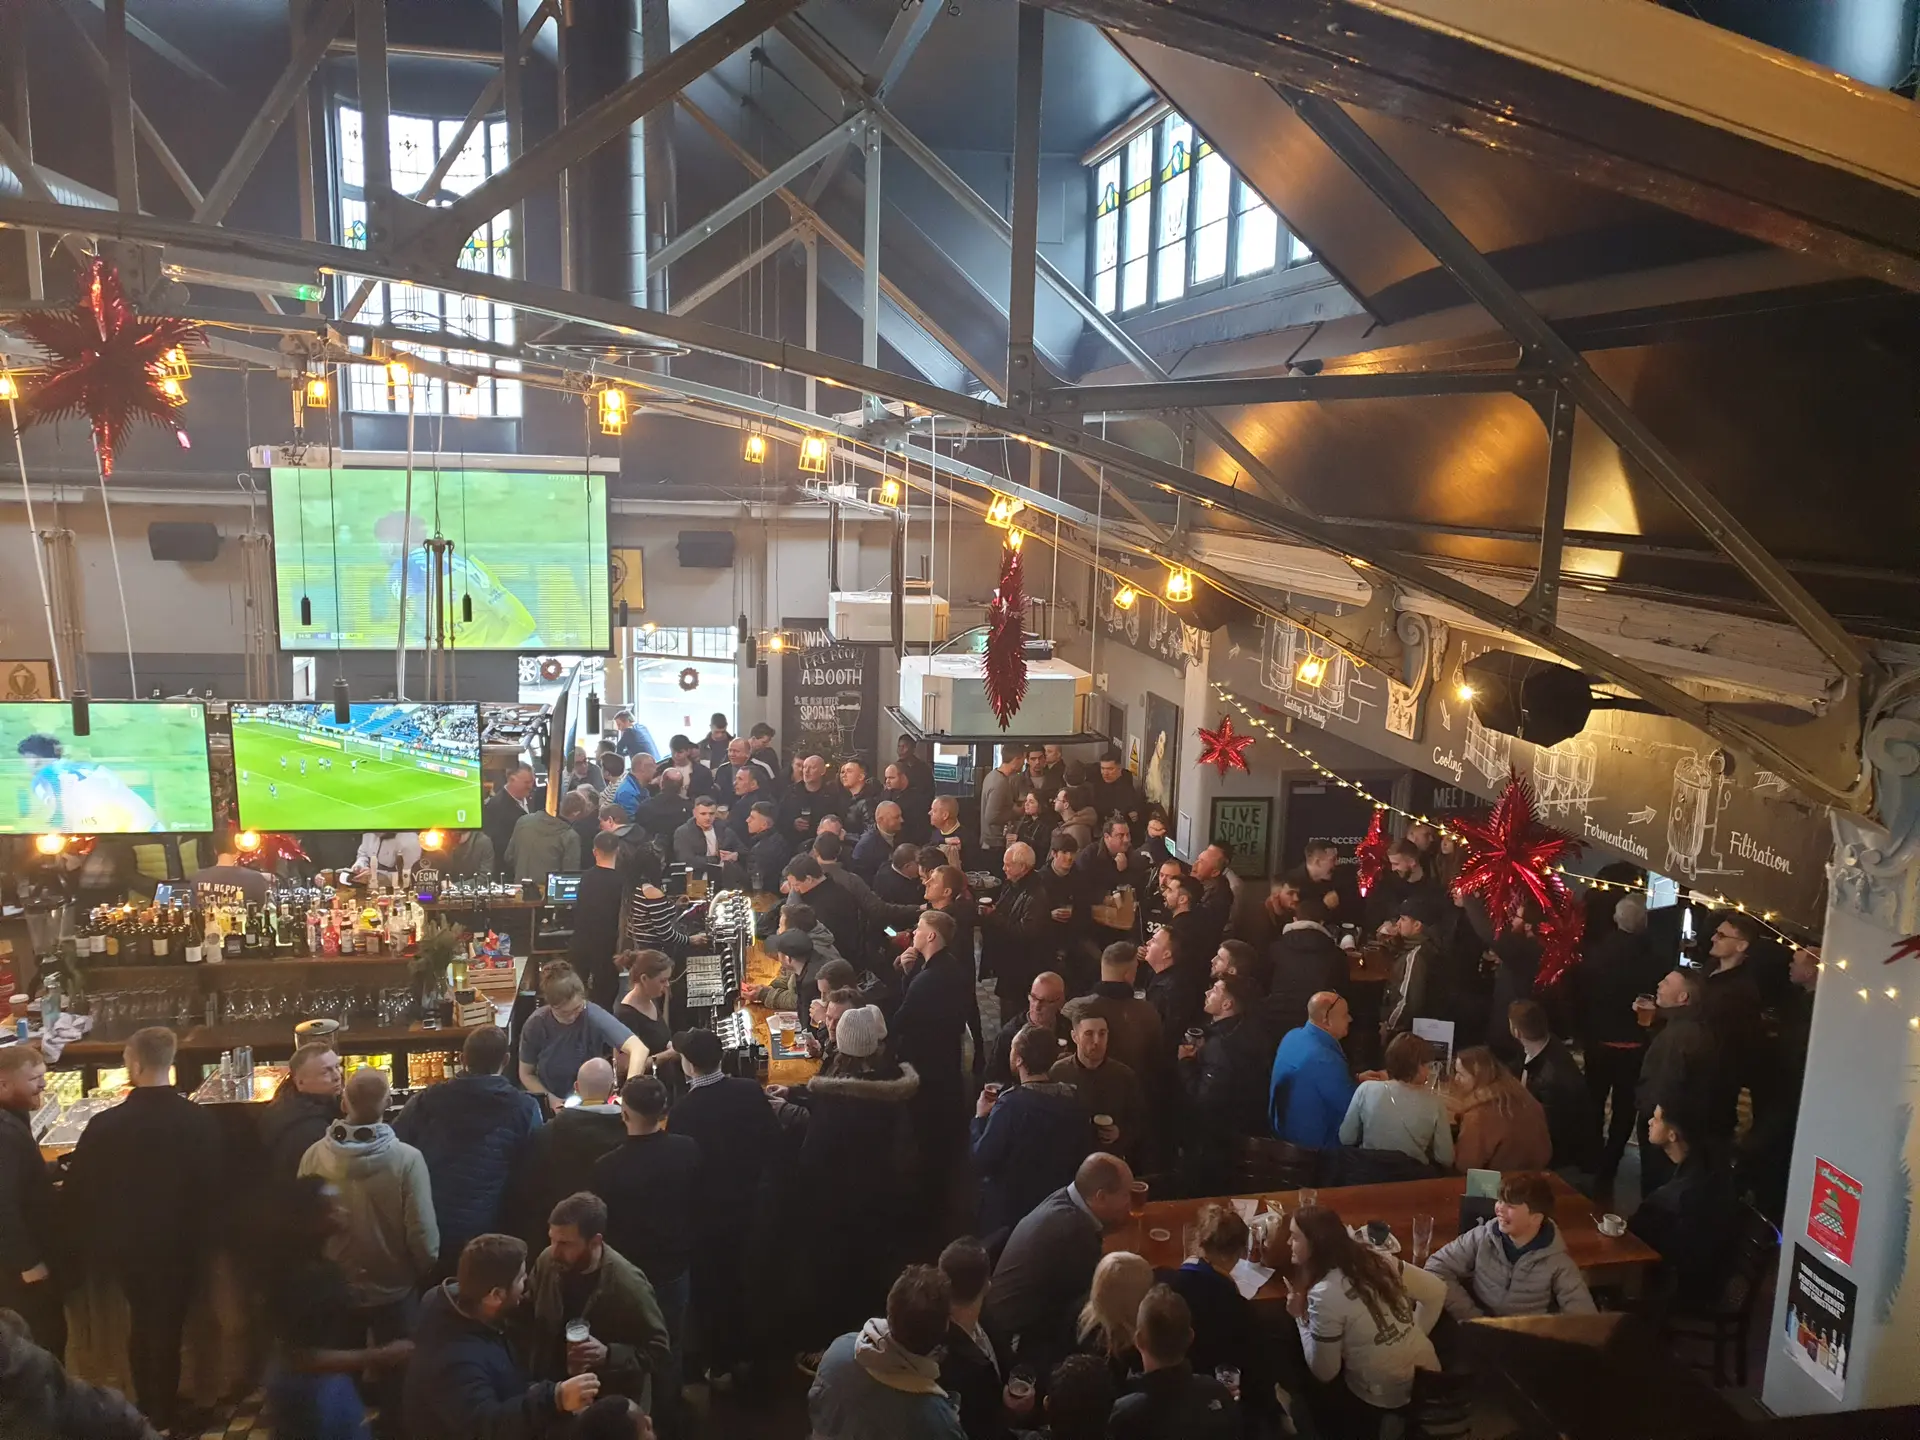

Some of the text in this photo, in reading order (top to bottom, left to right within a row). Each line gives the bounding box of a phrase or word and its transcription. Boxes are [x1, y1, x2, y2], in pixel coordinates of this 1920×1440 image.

[801, 668, 862, 686] A BOOTH
[800, 705, 836, 721] SPORTS
[1432, 746, 1464, 782] Cooling
[1221, 807, 1261, 826] LIVE
[1220, 821, 1260, 842] SPORT
[1583, 815, 1649, 861] Fermentation
[1729, 830, 1793, 875] Filtration
[412, 869, 440, 882] VEGAN
